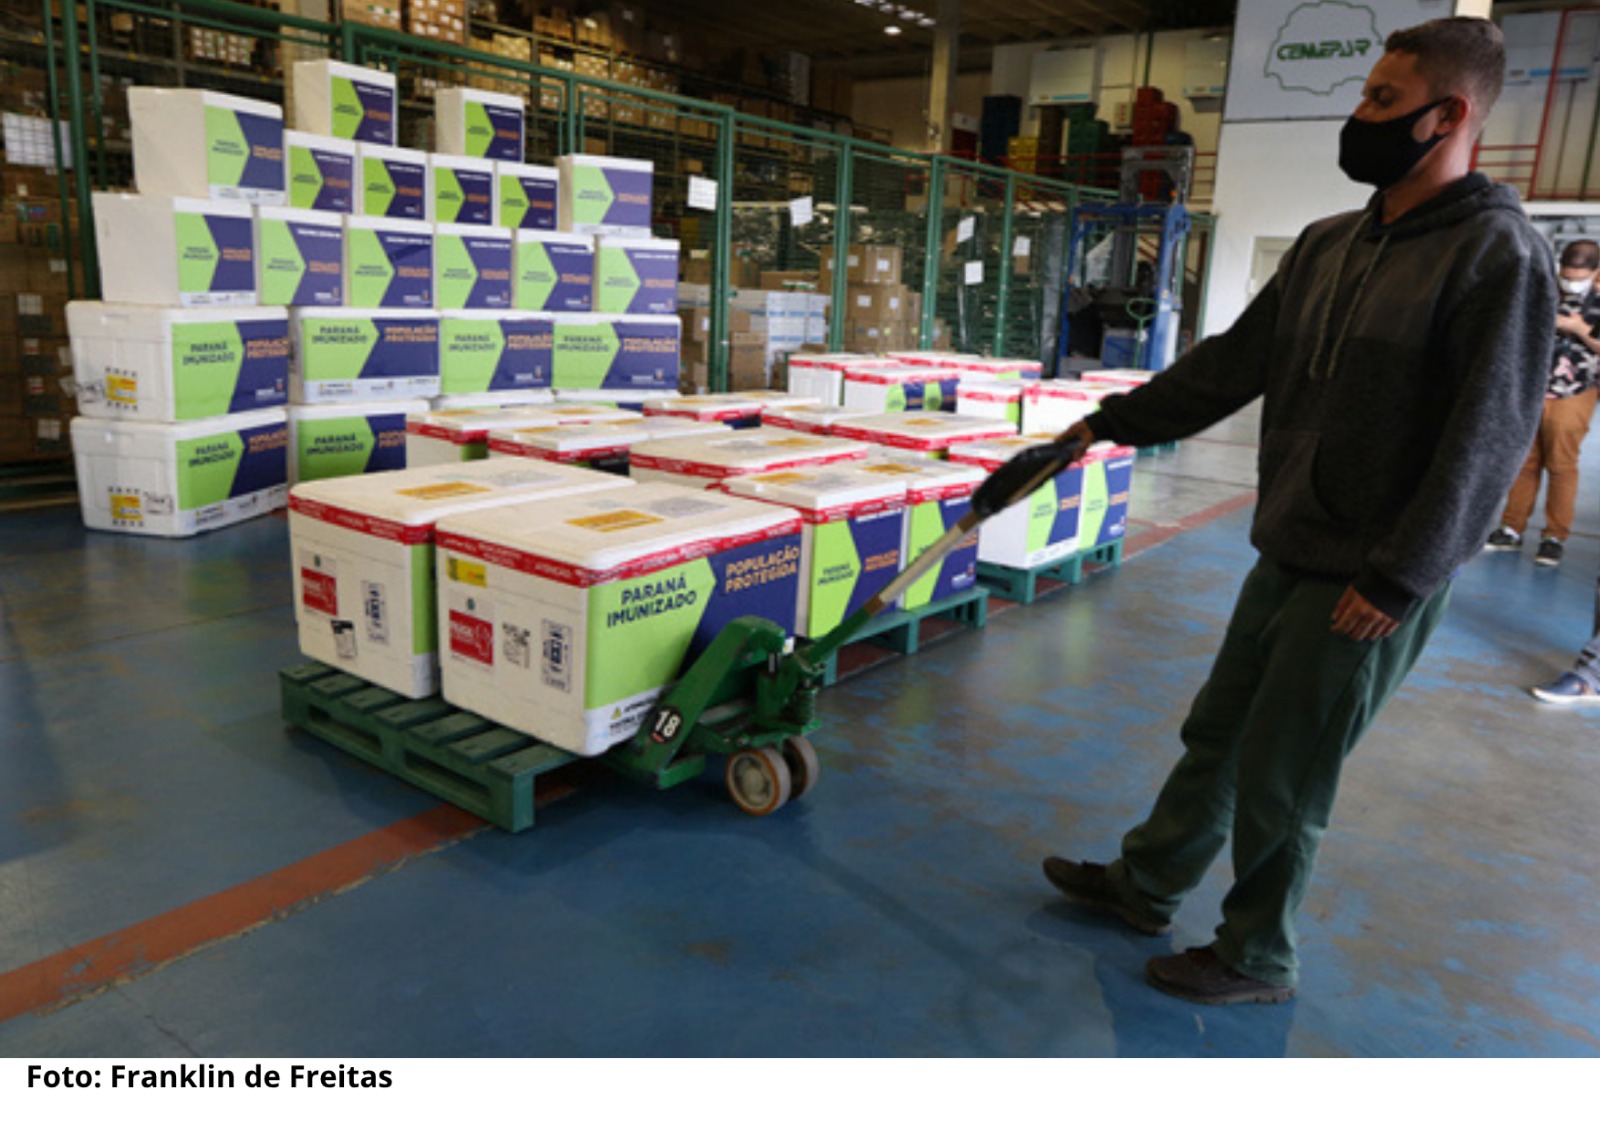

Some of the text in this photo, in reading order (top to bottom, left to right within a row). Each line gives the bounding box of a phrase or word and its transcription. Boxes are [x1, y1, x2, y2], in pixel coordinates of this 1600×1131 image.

[725, 561, 797, 593] PROTEGIDA
[726, 545, 800, 578] POPULAÇÃO
[621, 572, 688, 605] PARANÁ
[607, 590, 698, 629] IMUNIZADO
[655, 709, 681, 737] 18
